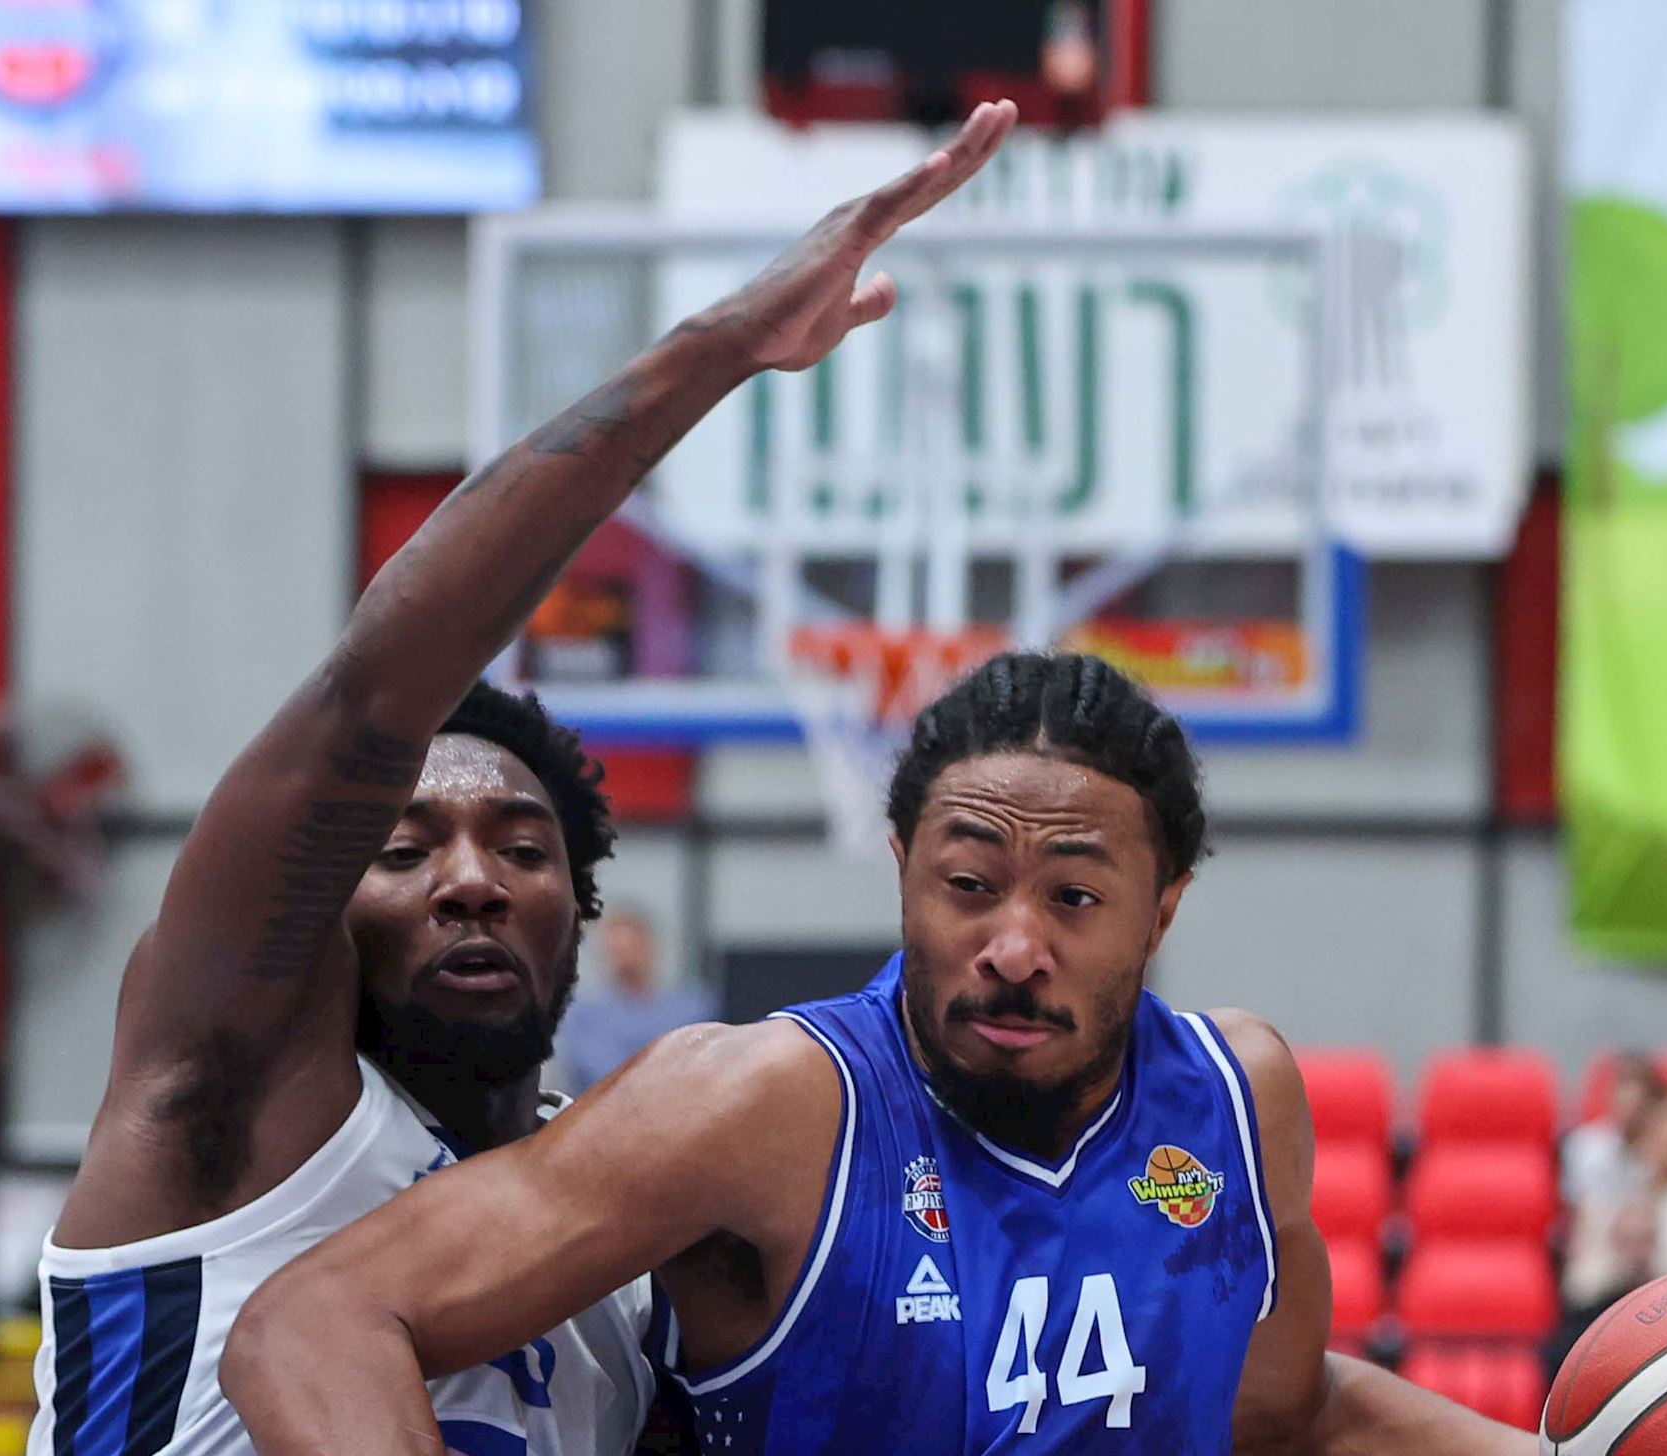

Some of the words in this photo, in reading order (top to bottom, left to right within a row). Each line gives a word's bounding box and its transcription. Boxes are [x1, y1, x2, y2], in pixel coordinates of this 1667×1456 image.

[1131, 1178, 1207, 1201] Winner
[895, 1295, 961, 1325] PEAK
[985, 1272, 1147, 1434] 44
